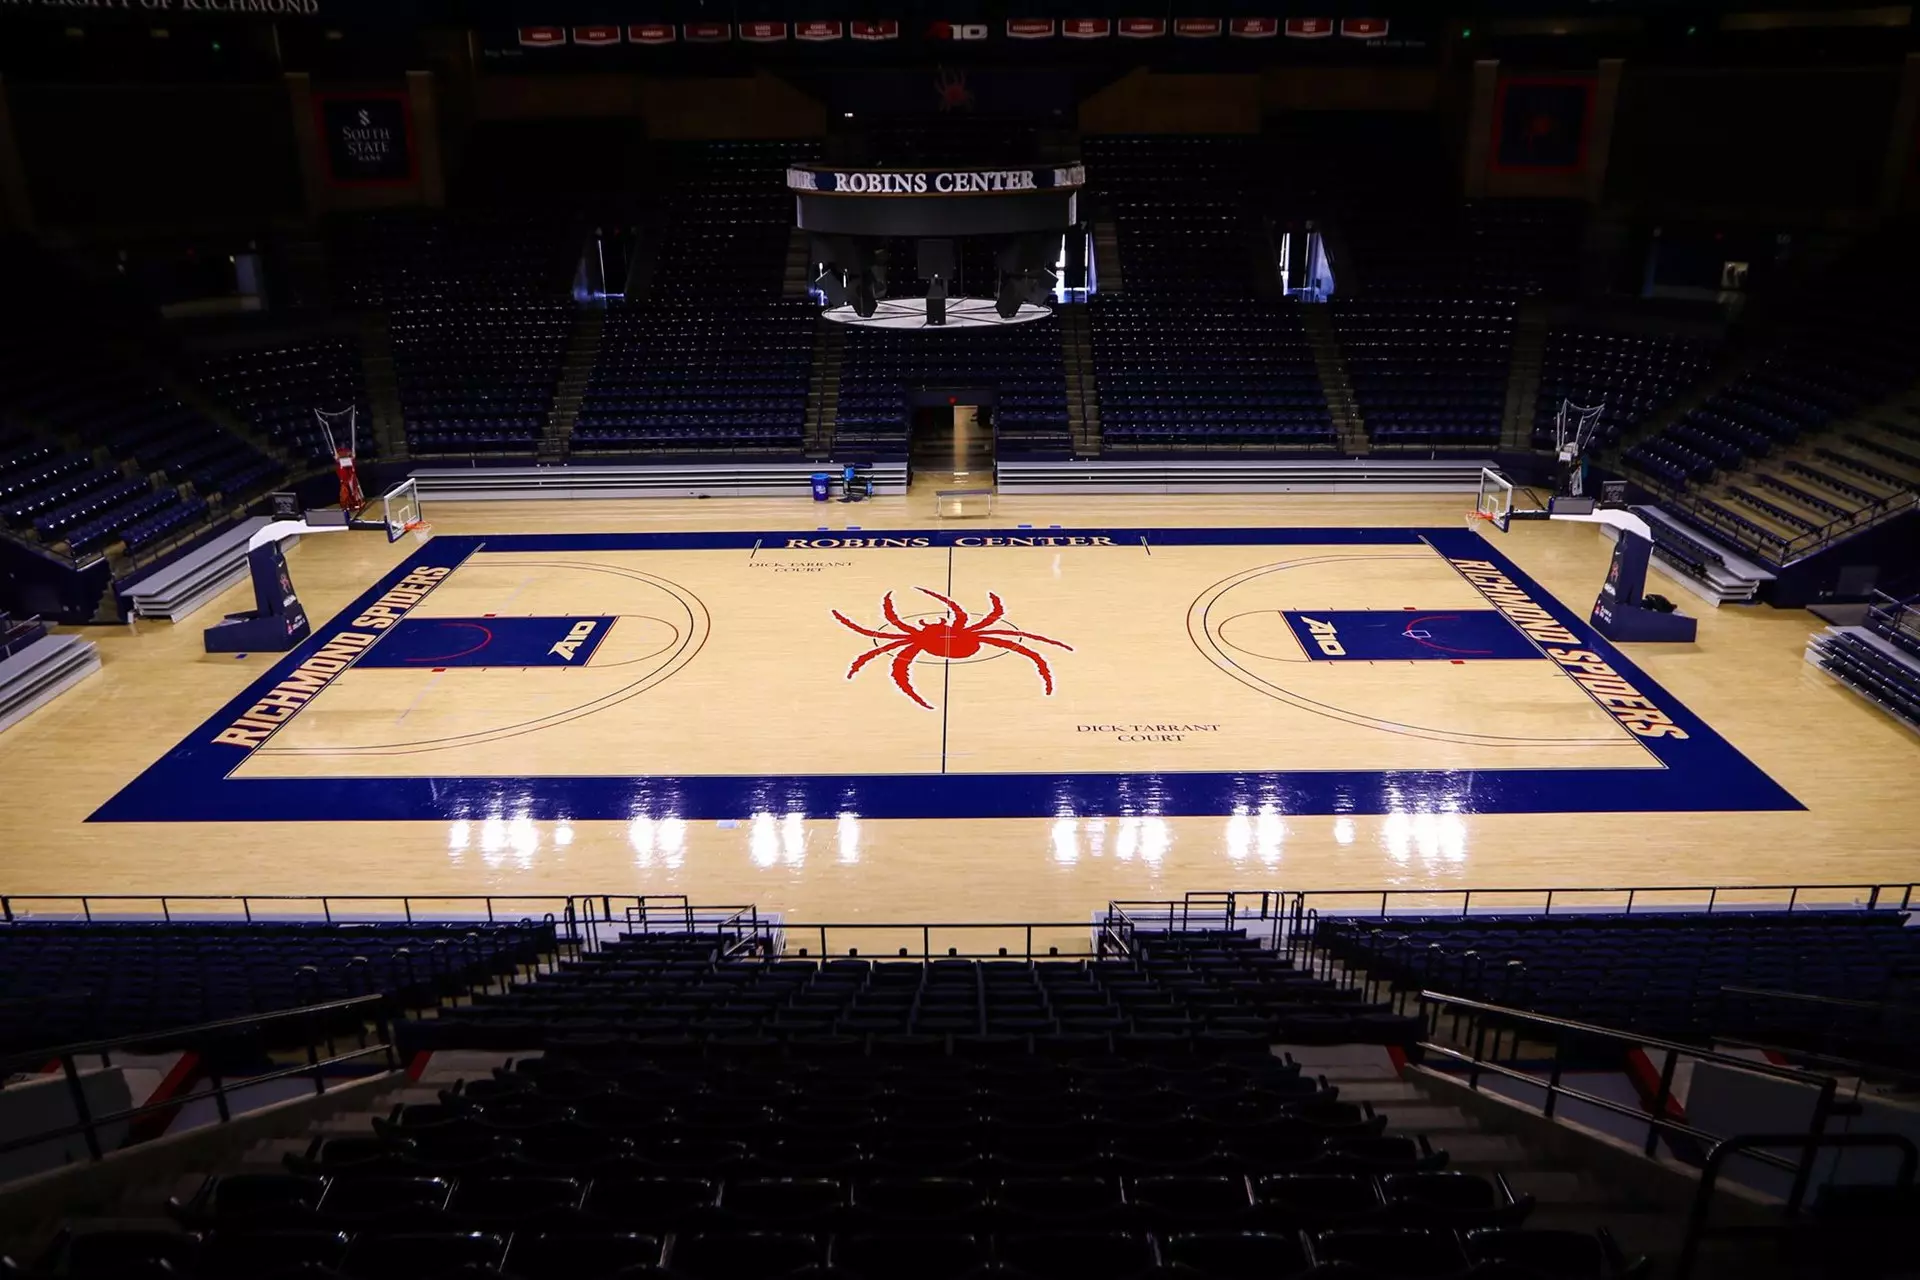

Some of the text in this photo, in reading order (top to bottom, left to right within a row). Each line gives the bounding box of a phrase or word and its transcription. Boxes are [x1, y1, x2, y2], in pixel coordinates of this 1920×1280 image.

[342, 126, 392, 142] SOUTH
[347, 141, 390, 156] STATE
[834, 171, 1038, 194] ROBINS CENTER
[787, 536, 1117, 548] ROBINS CENTER
[1448, 557, 1690, 740] RICHMOND SPIDERS
[210, 565, 451, 749] RICHMOND SPIDERS
[1076, 724, 1221, 733] DICK TARRANT
[1117, 734, 1186, 743] COURT
